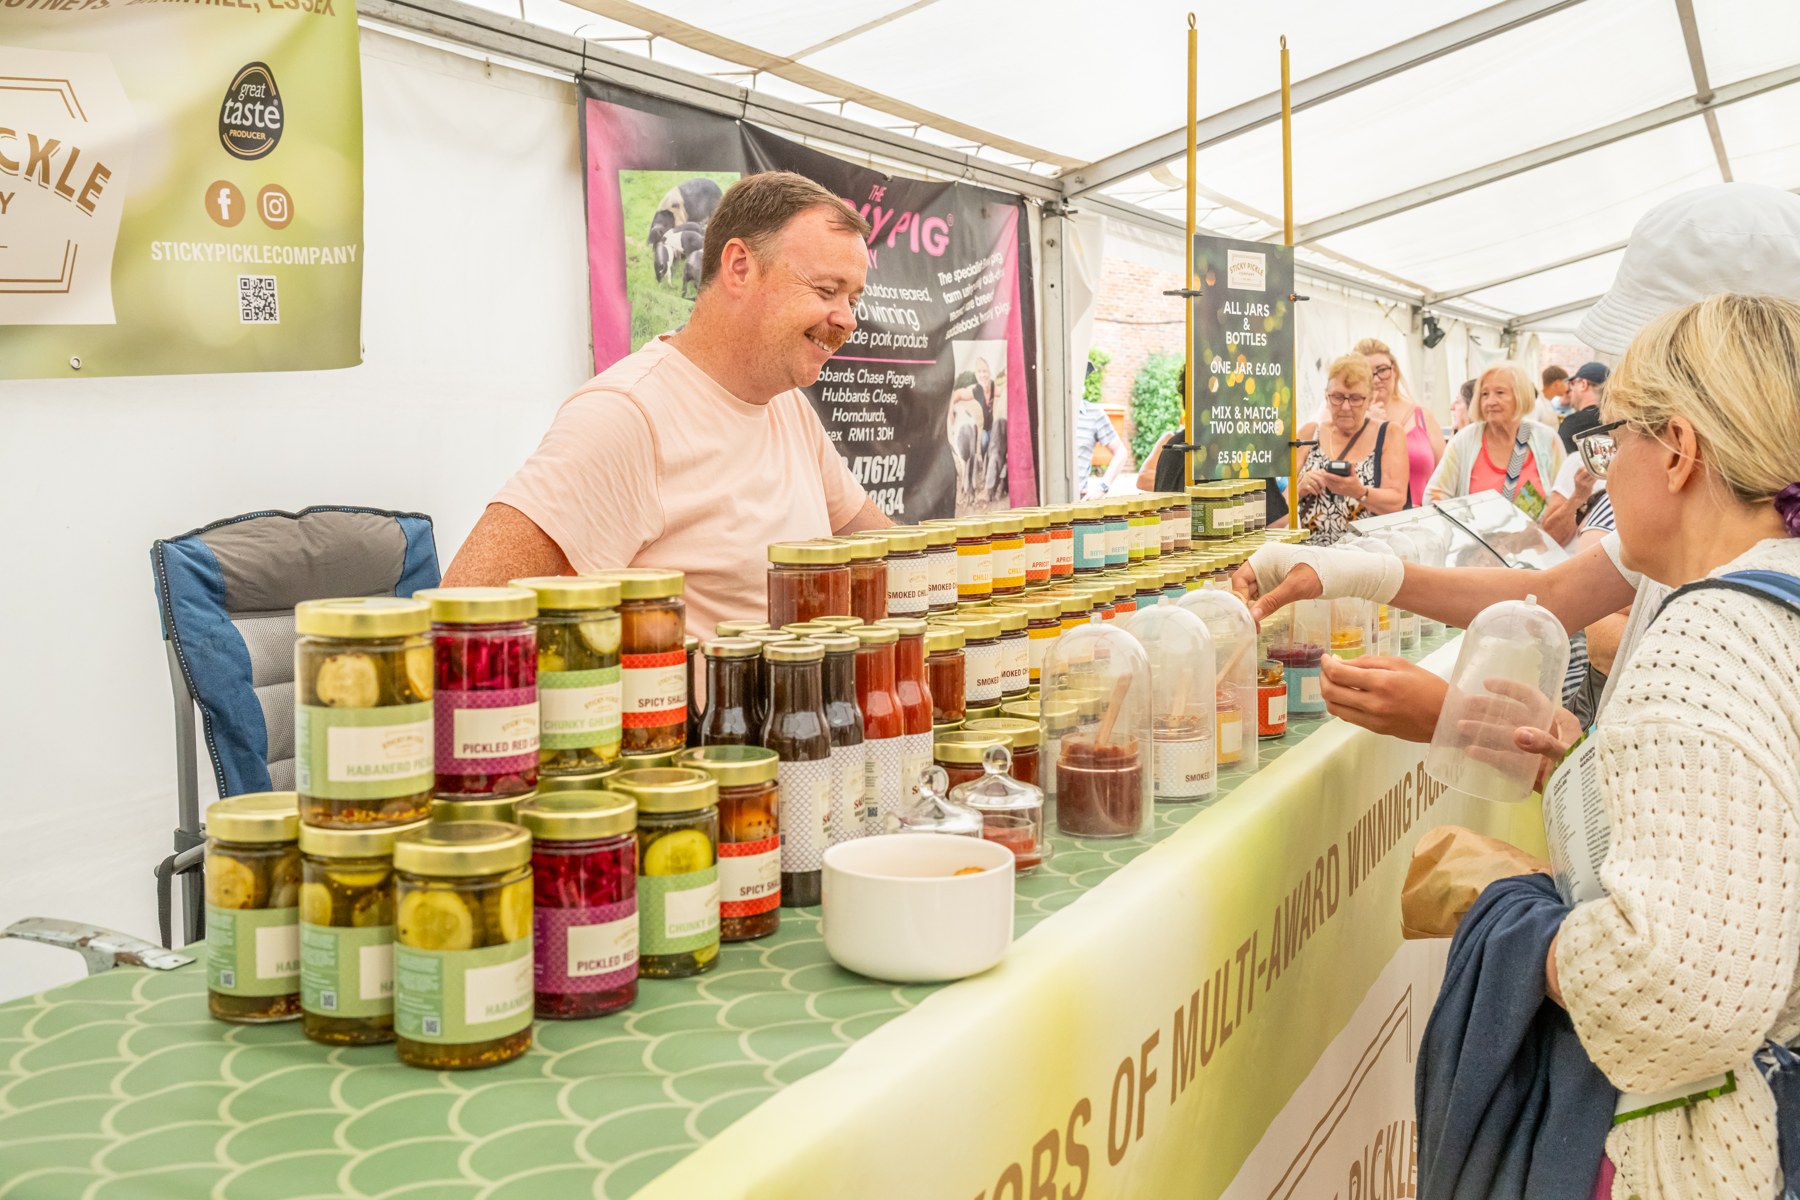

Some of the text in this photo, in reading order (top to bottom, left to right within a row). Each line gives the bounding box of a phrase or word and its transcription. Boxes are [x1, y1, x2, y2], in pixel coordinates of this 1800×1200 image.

[238, 83, 266, 100] great
[223, 98, 281, 129] taste
[229, 129, 266, 139] PRODUCER
[868, 184, 887, 202] THE
[150, 240, 357, 265] STICKYPICKLECOMPANY
[937, 271, 953, 287] The
[898, 287, 933, 303] reared,
[942, 289, 963, 305] farm
[868, 301, 921, 332] winning
[1223, 300, 1270, 317] ALL JARS
[1242, 317, 1251, 331] &
[869, 331, 892, 349] pork
[892, 332, 929, 350] products
[1225, 331, 1267, 347] BOTTLES
[1210, 360, 1281, 377] ONE JAR £6.00
[856, 368, 885, 384] Chase
[885, 370, 916, 389] Piggery,
[821, 386, 899, 406] Hubbards Close,
[831, 407, 887, 424] Hornchurch,
[1211, 405, 1279, 420] MIX & MATCH
[847, 427, 875, 442] RM11
[876, 426, 895, 441] 3DH
[1209, 421, 1281, 435] TWO OR MORE
[1217, 450, 1272, 465] £5.50 EACH
[851, 453, 906, 485] 476124
[887, 590, 916, 600] SMOKED
[638, 697, 665, 708] SPICY
[462, 742, 510, 755] PICKLED
[511, 738, 529, 751] RED
[739, 883, 765, 897] SPICY
[576, 954, 622, 972] PICKLED
[1107, 1027, 1161, 1167] OF
[1170, 843, 1340, 1107] MULTI-AWARD
[1346, 777, 1413, 898] WINNING
